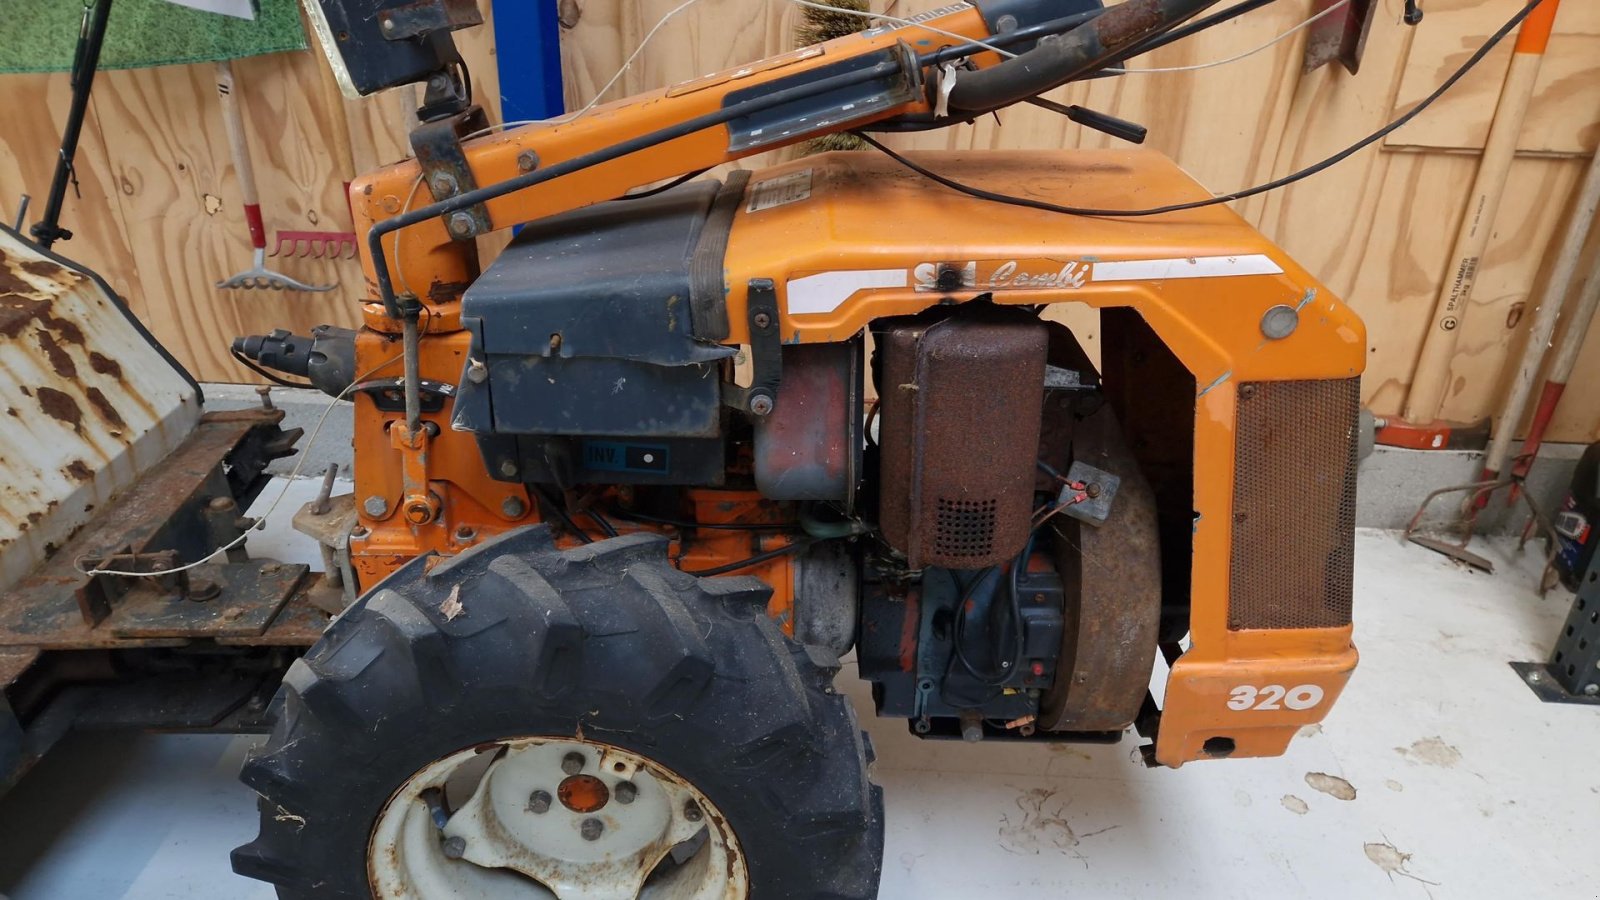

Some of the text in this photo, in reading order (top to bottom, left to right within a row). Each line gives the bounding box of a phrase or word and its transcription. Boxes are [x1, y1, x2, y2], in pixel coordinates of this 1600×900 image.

[989, 260, 1090, 289] Combi
[1446, 257, 1470, 311] SPALTHAMMER
[1226, 684, 1324, 711] 320
